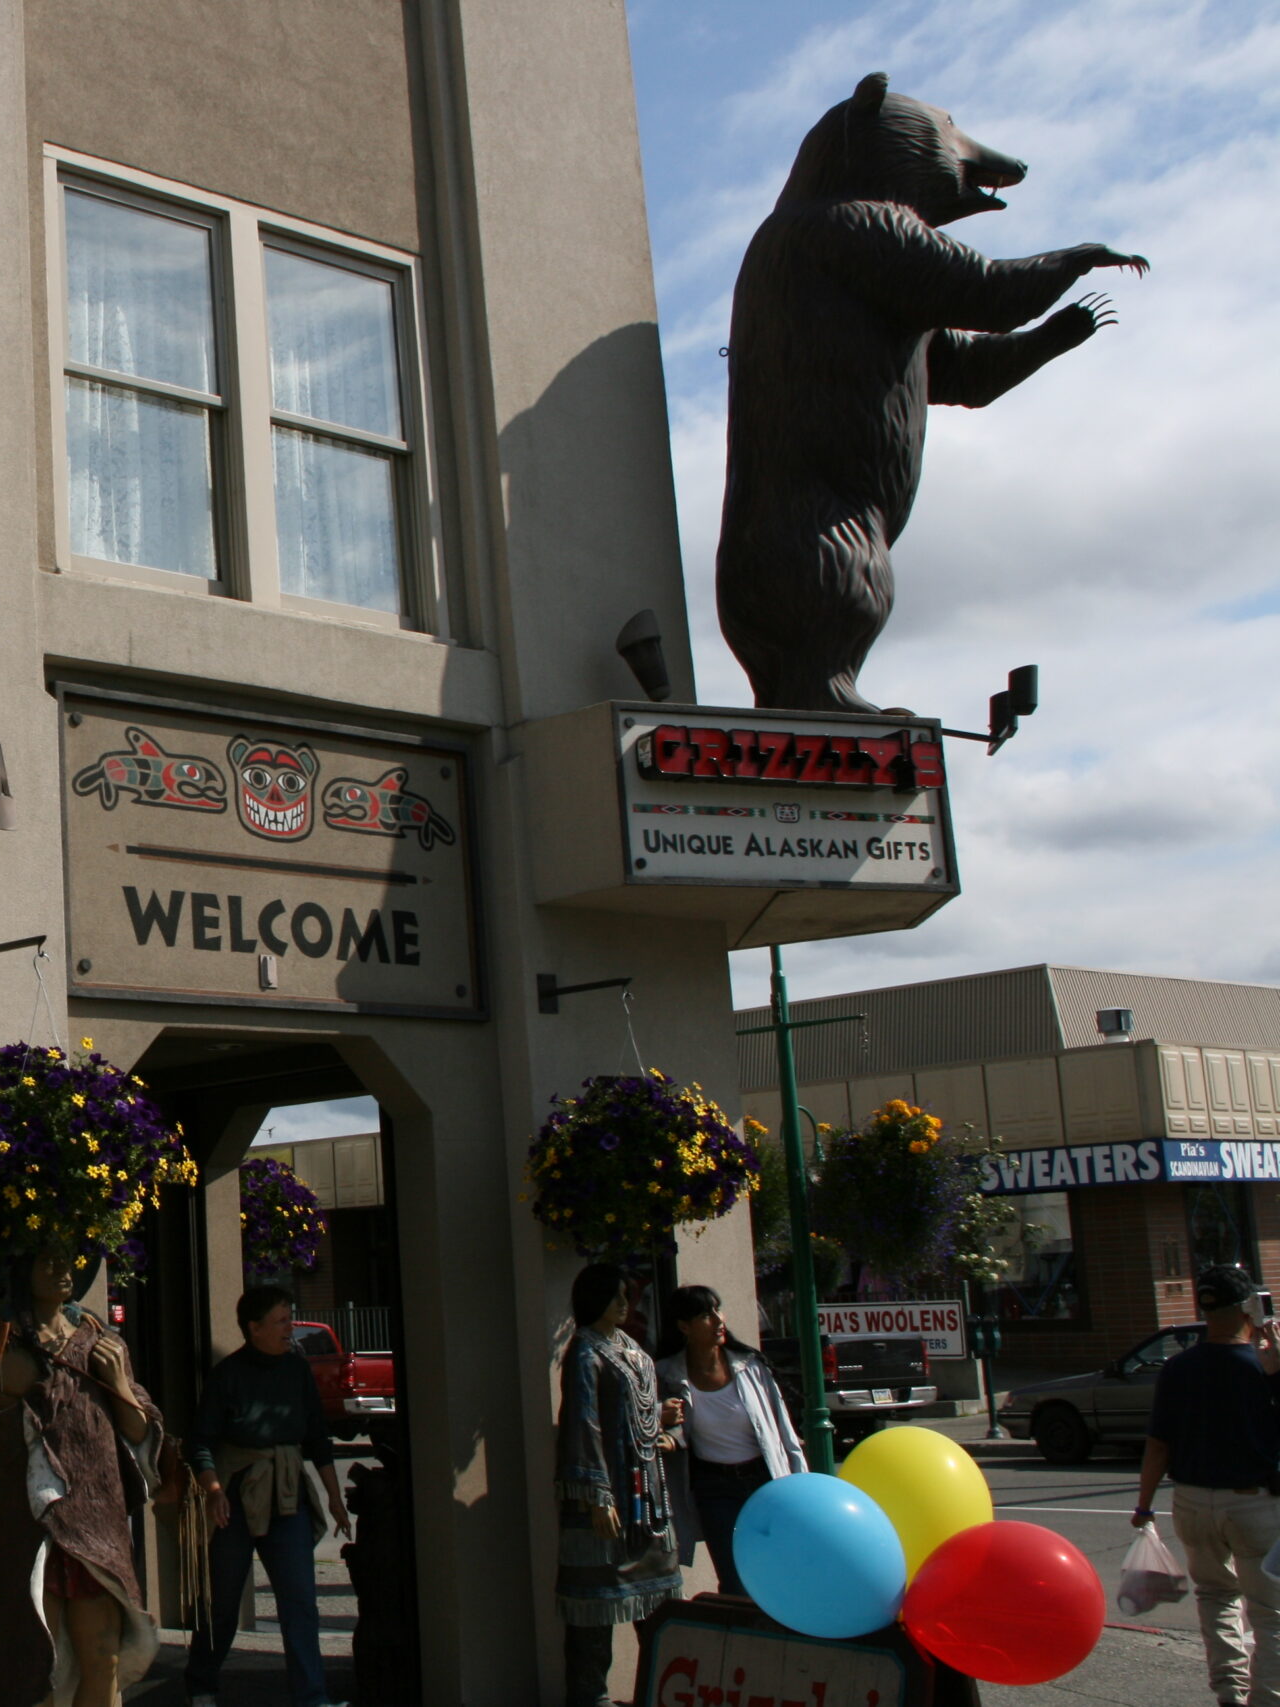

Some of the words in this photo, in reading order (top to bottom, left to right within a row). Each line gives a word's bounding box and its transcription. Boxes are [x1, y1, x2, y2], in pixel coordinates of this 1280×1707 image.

[654, 724, 946, 789] GRIZZLY'S
[643, 828, 734, 856] UNIQUE
[744, 832, 859, 860] ALASKAN
[866, 836, 931, 862] GIFTS
[121, 886, 420, 966] WELCOME
[979, 1141, 1161, 1191] SWEATERS
[1180, 1142, 1206, 1157] Pia's
[1170, 1161, 1220, 1177] SCANDINAVIAN
[818, 1311, 861, 1333] PIA'S
[865, 1309, 959, 1333] WOOLENS
